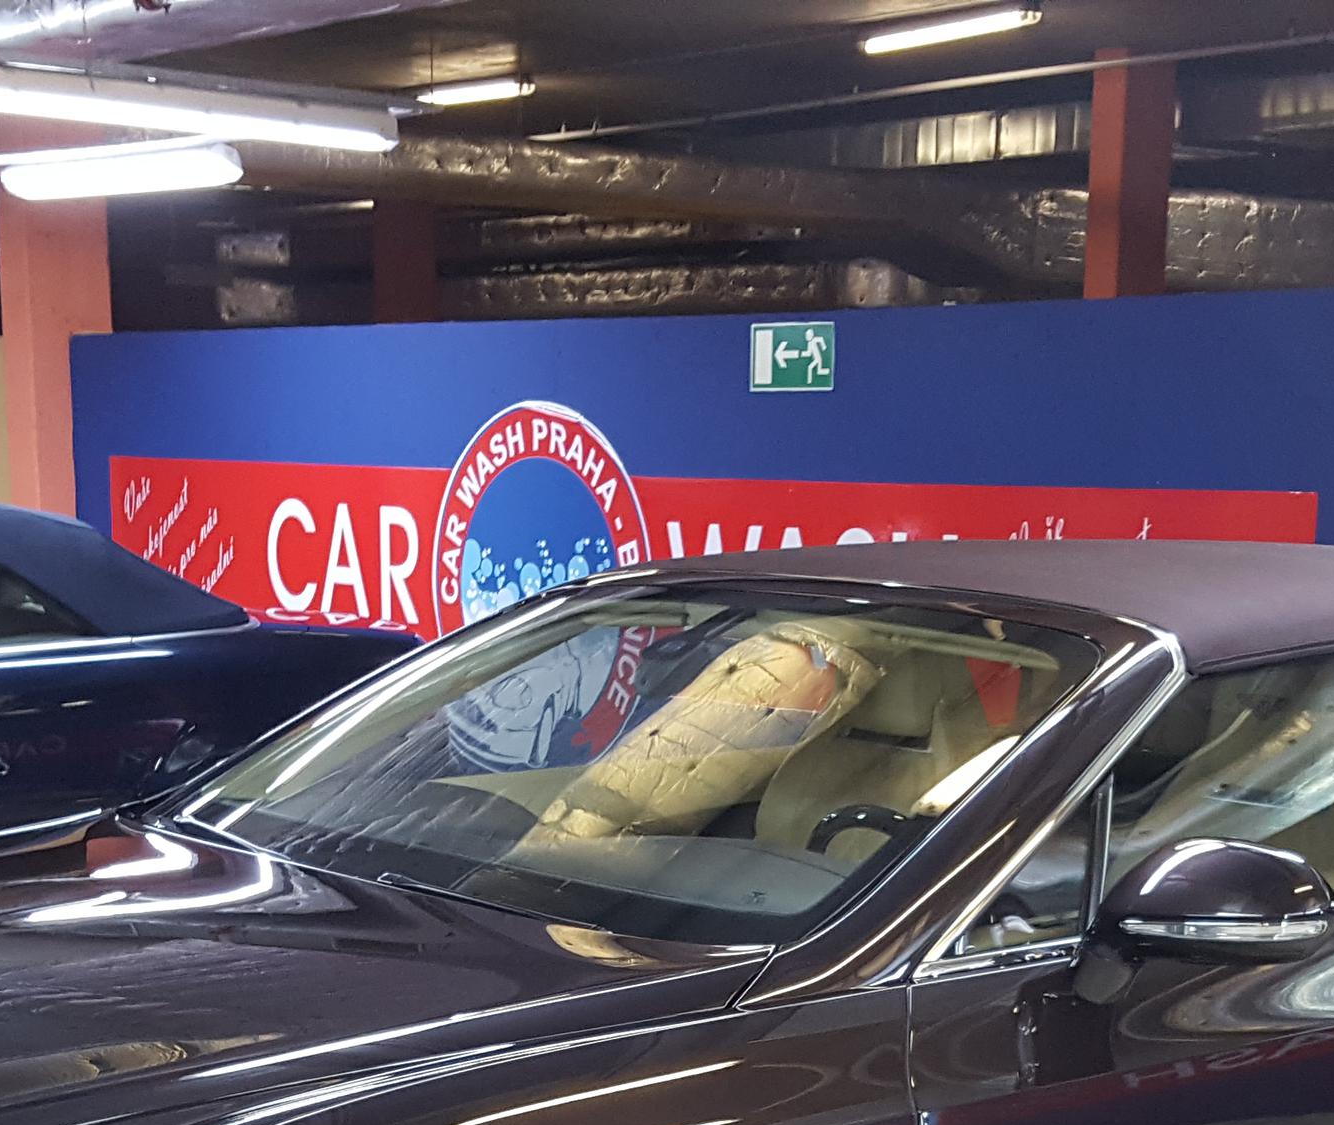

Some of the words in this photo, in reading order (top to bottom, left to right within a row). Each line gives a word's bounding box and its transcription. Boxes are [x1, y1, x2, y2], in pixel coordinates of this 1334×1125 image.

[267, 498, 420, 624] CAR
[441, 514, 467, 605] CAR
[456, 421, 525, 510] WASH
[532, 418, 618, 513] PRAHA
[617, 539, 640, 567] B
